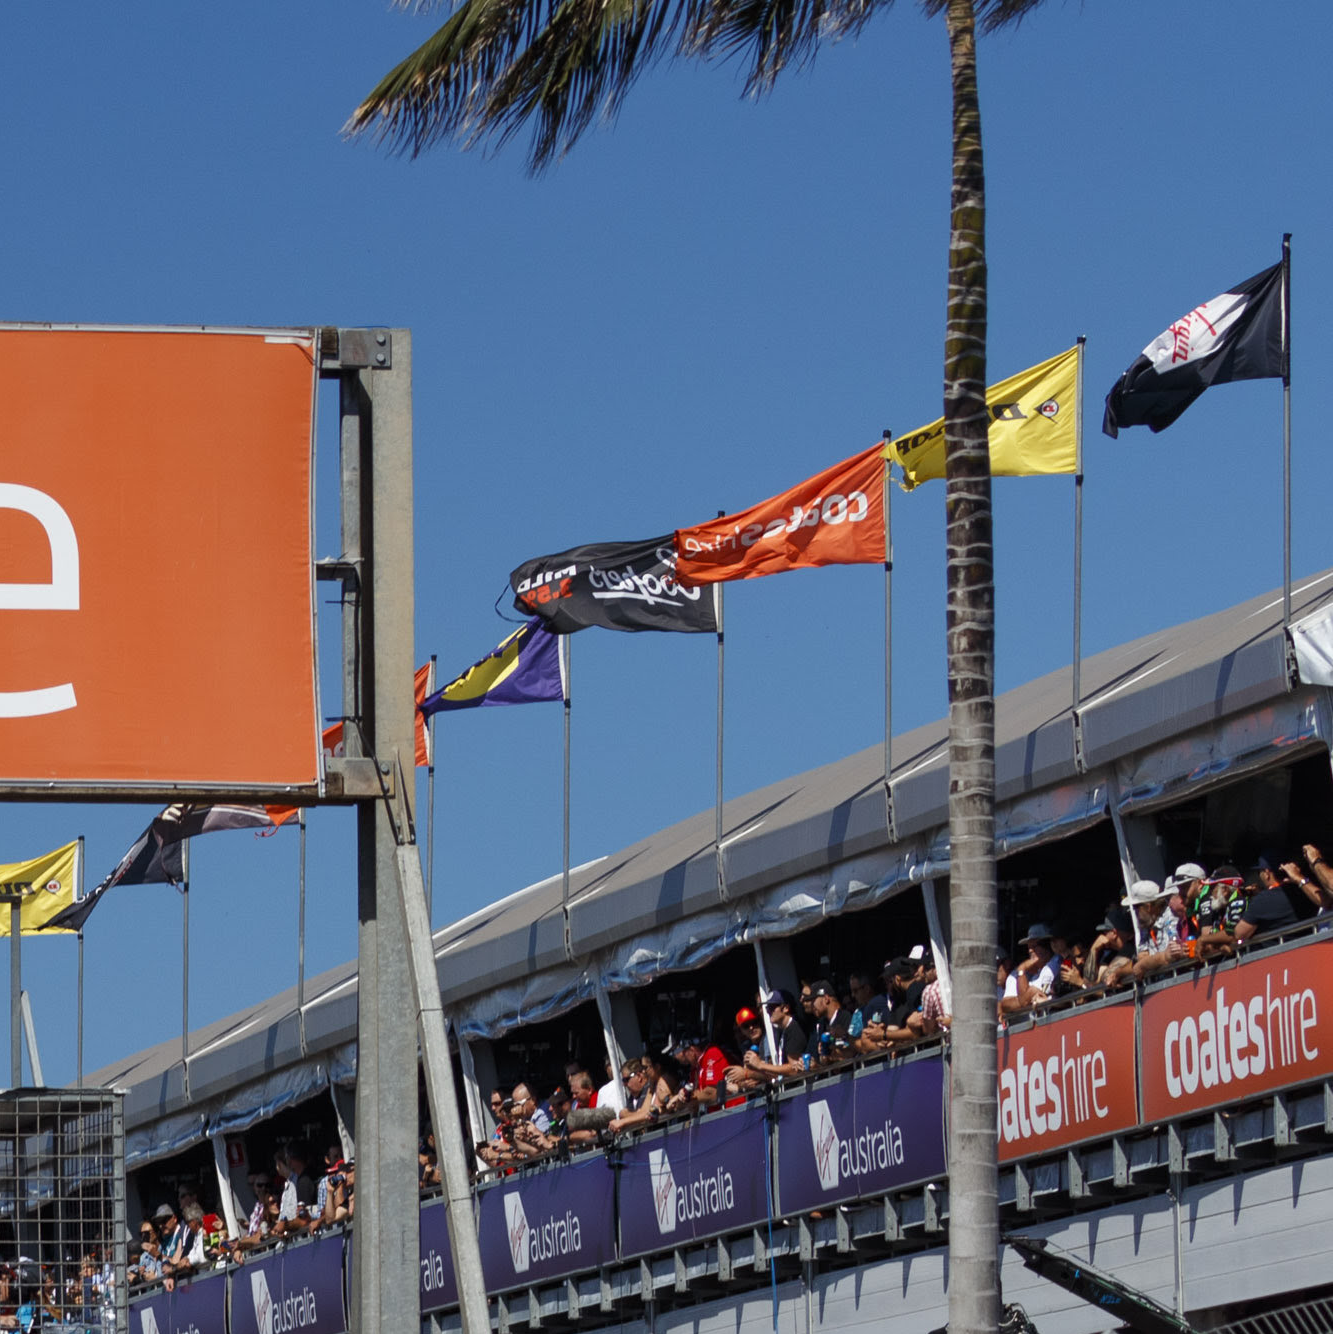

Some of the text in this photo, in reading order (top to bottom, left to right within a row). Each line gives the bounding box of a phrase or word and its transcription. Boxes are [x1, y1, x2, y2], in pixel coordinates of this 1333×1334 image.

[840, 1119, 905, 1179] australia
[677, 1165, 735, 1223] australia
[529, 1210, 582, 1263] australia
